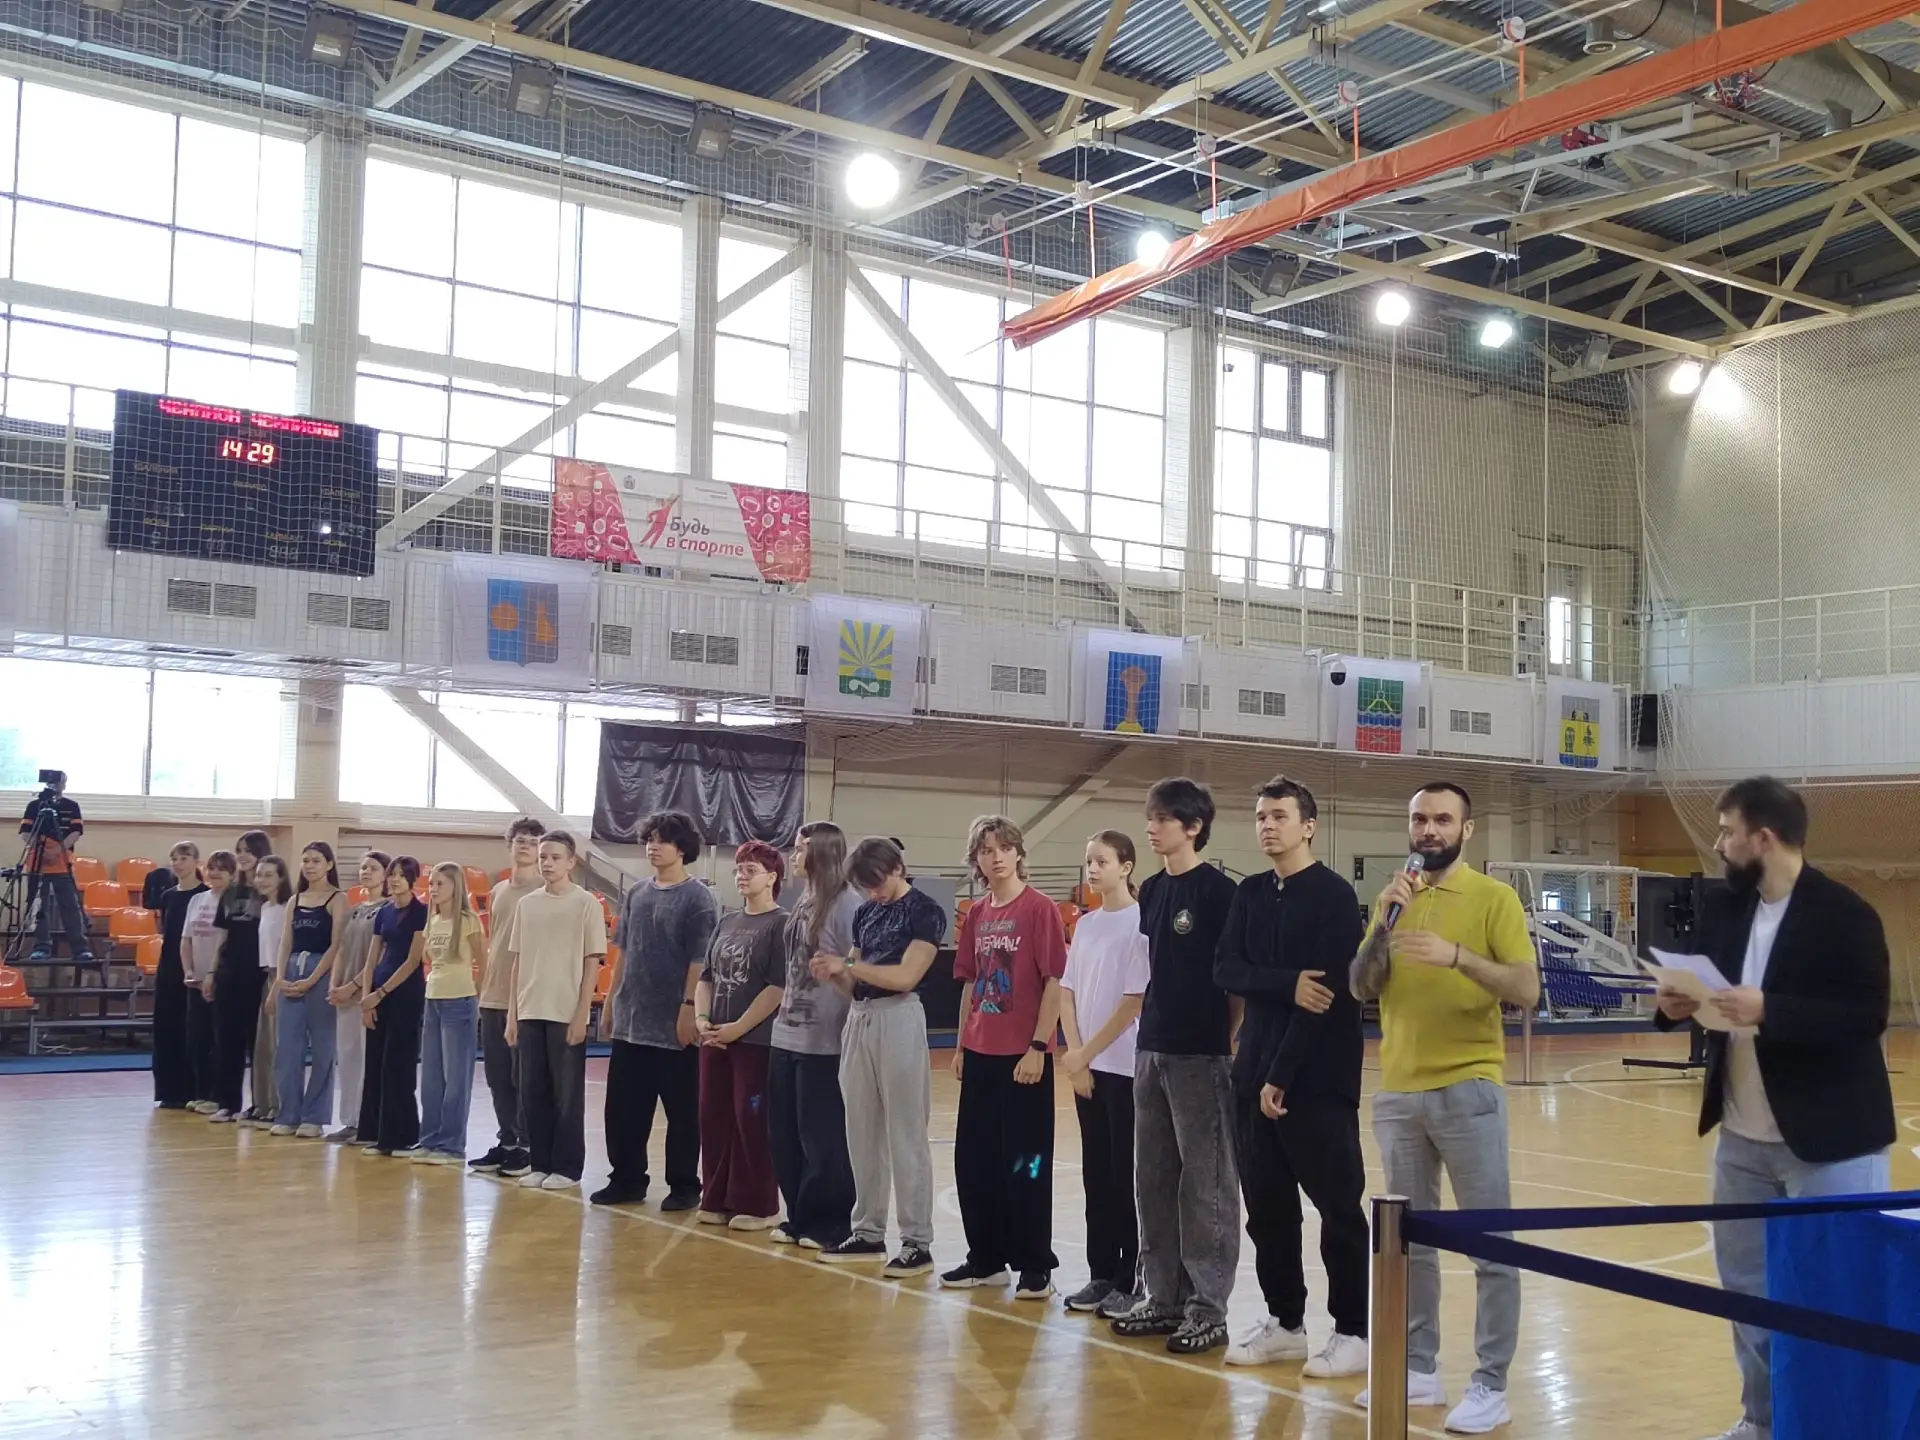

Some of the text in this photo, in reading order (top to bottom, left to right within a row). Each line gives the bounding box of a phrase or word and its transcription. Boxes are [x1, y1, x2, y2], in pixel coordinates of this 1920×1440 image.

[222, 440, 275, 465] 14 29
[670, 516, 711, 536] Будь
[666, 537, 745, 558] в спорте
